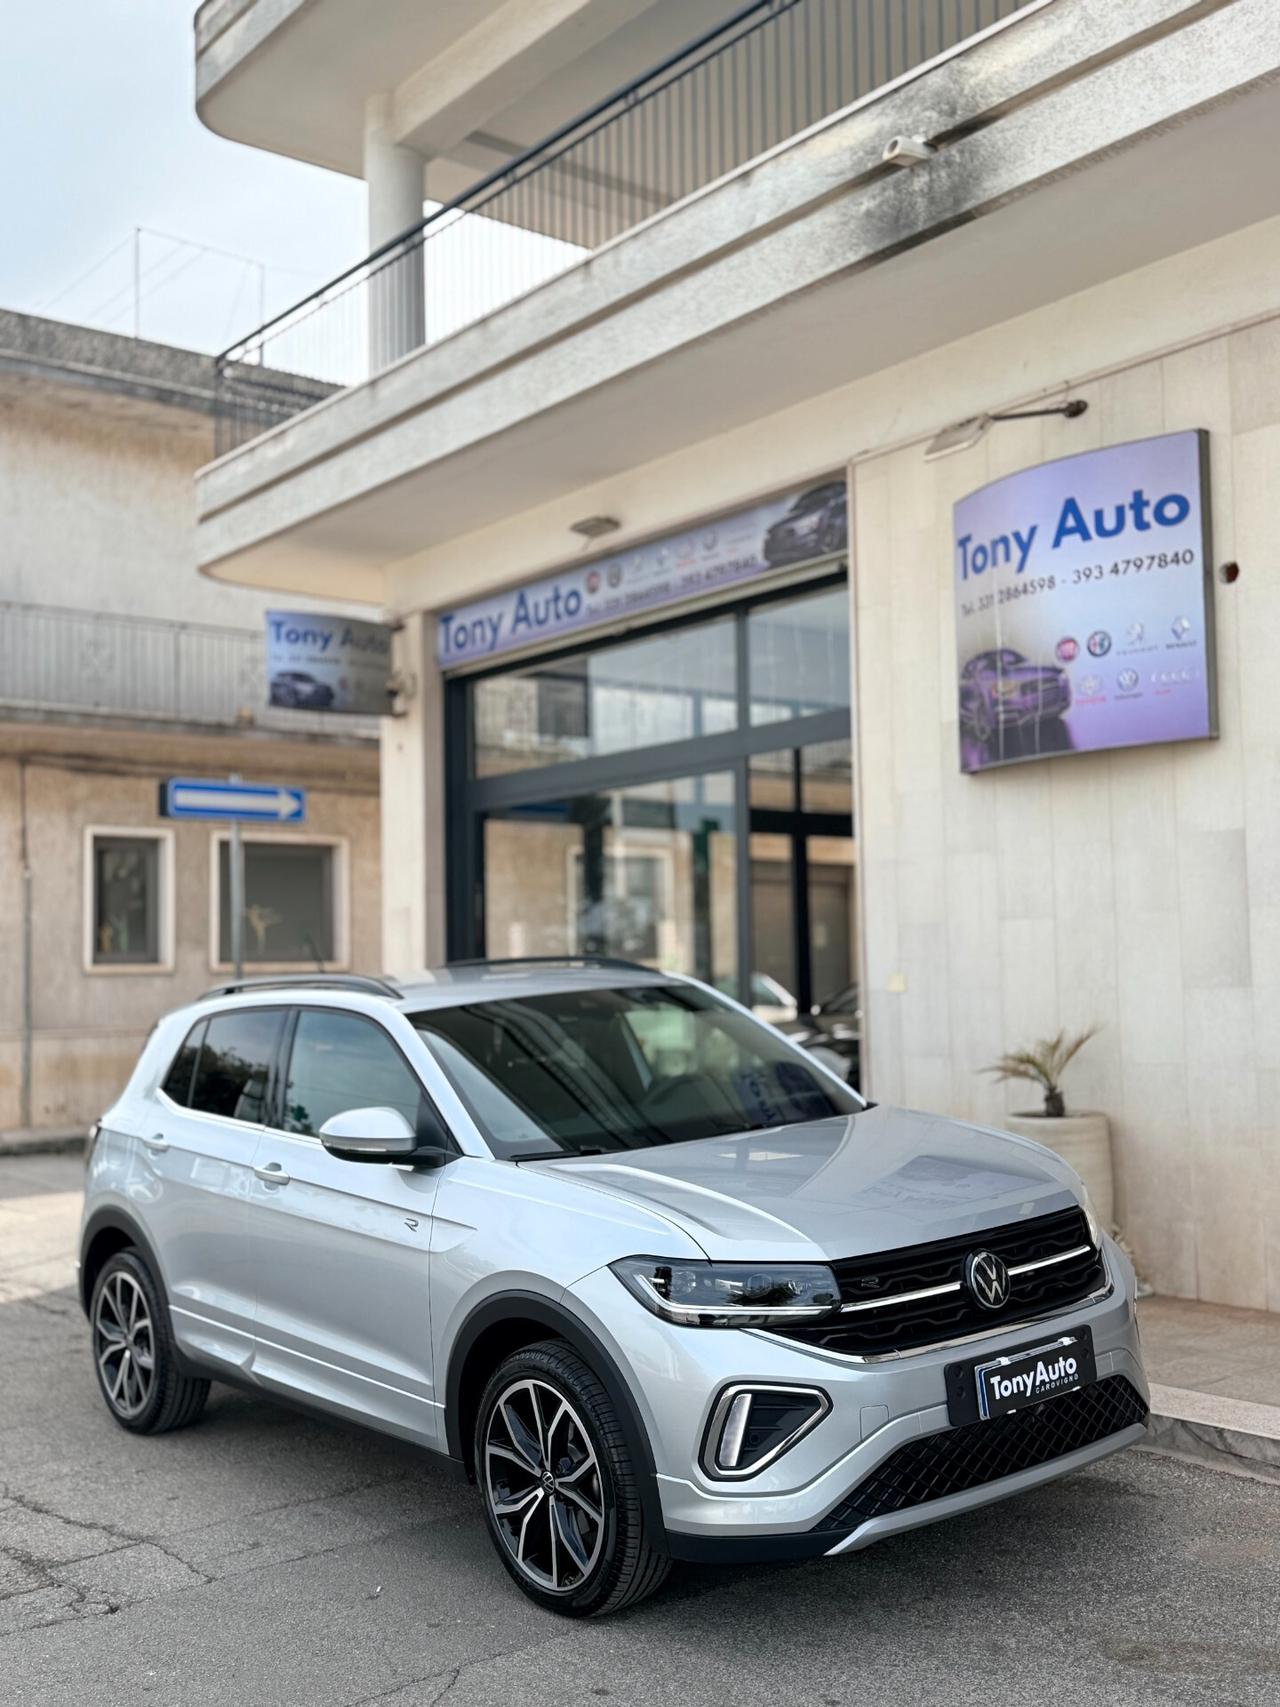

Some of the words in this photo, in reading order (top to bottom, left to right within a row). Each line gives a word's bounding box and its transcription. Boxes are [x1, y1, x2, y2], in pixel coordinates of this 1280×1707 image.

[958, 524, 1039, 581] Tony
[1052, 489, 1191, 549] Auto
[1072, 563, 1104, 585] 393
[1109, 548, 1195, 576] 4797840
[271, 621, 333, 652] Tony
[440, 613, 504, 653] Tony
[511, 583, 582, 634] Auto
[1035, 1373, 1080, 1394] CAROVIGNO
